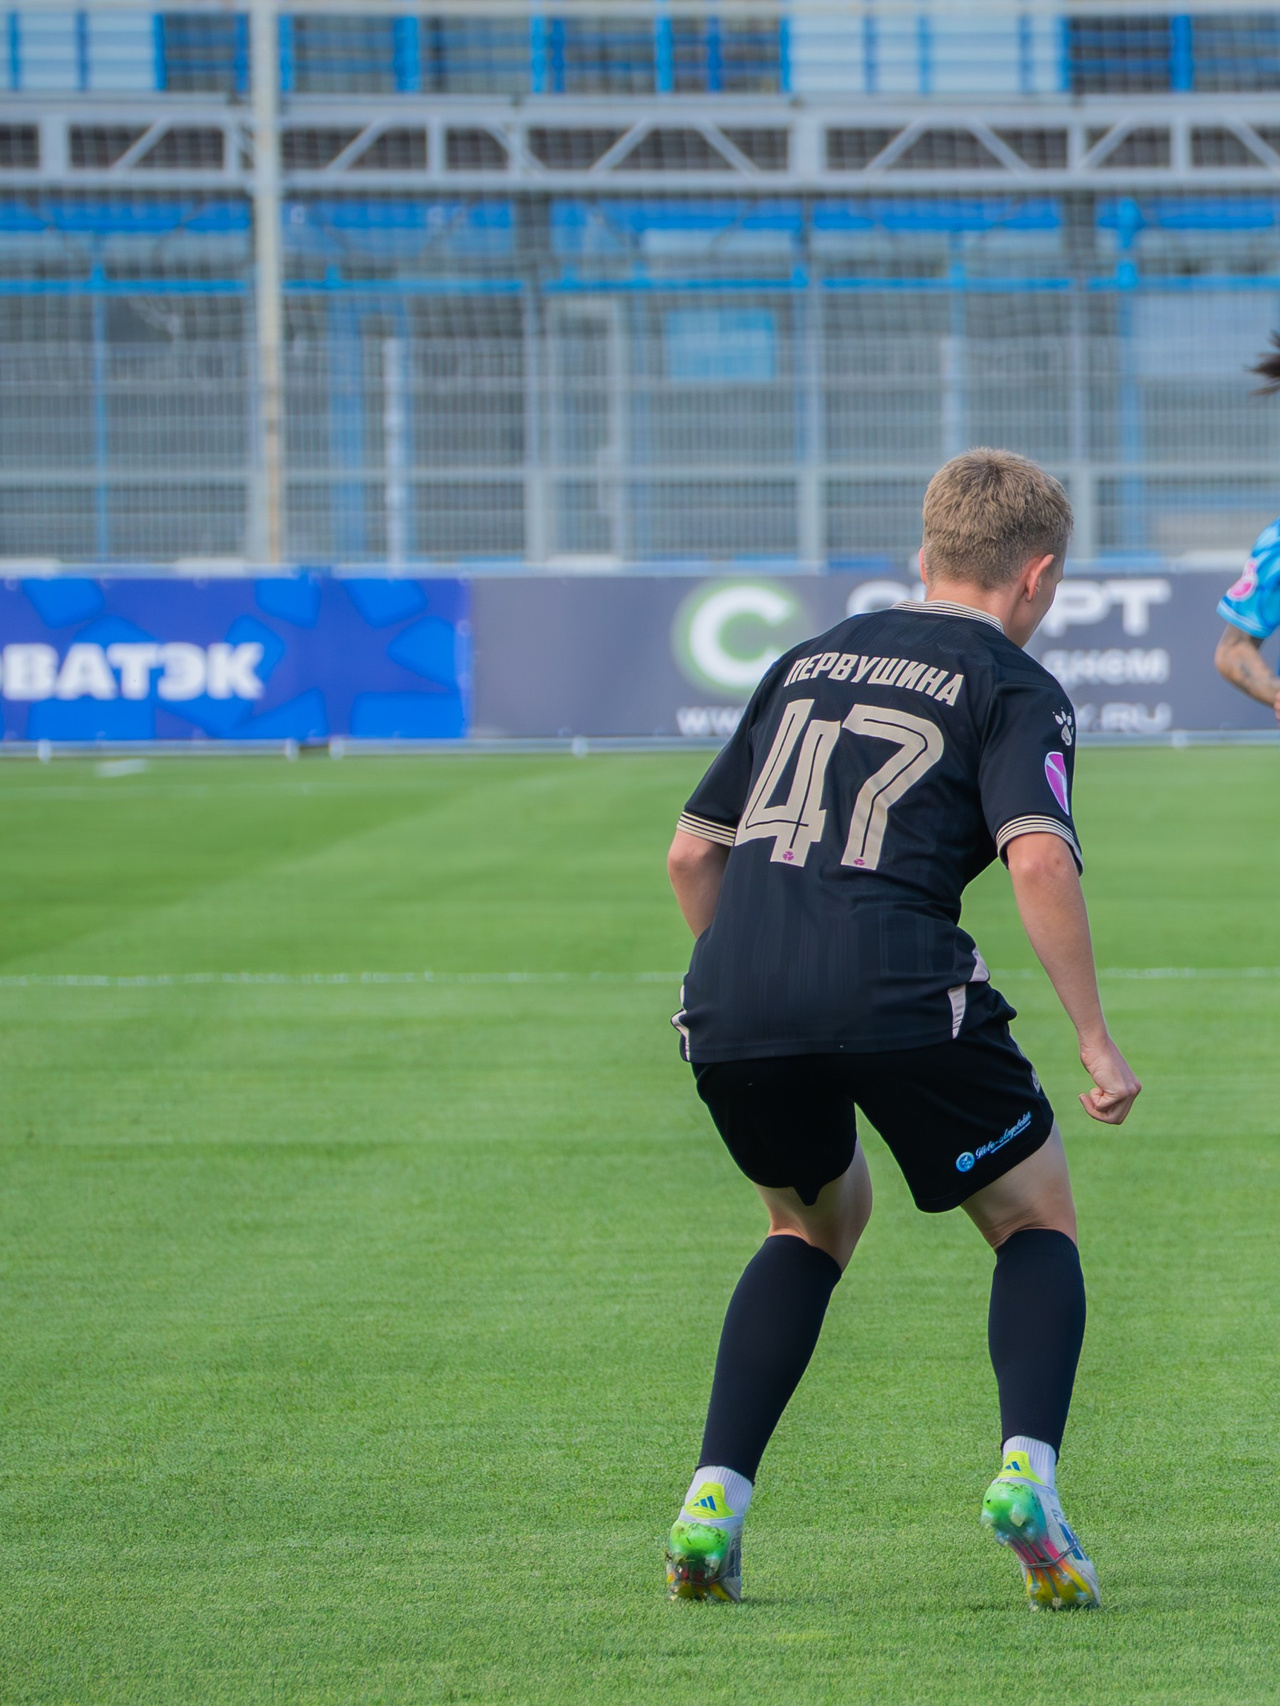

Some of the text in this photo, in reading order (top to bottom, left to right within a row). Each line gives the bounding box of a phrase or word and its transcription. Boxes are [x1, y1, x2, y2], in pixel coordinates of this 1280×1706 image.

[845, 580, 1173, 637] СРТ
[0, 642, 264, 698] ВАТЭК
[783, 652, 964, 707] ПЕРВУШИНА
[734, 699, 944, 870] 47
